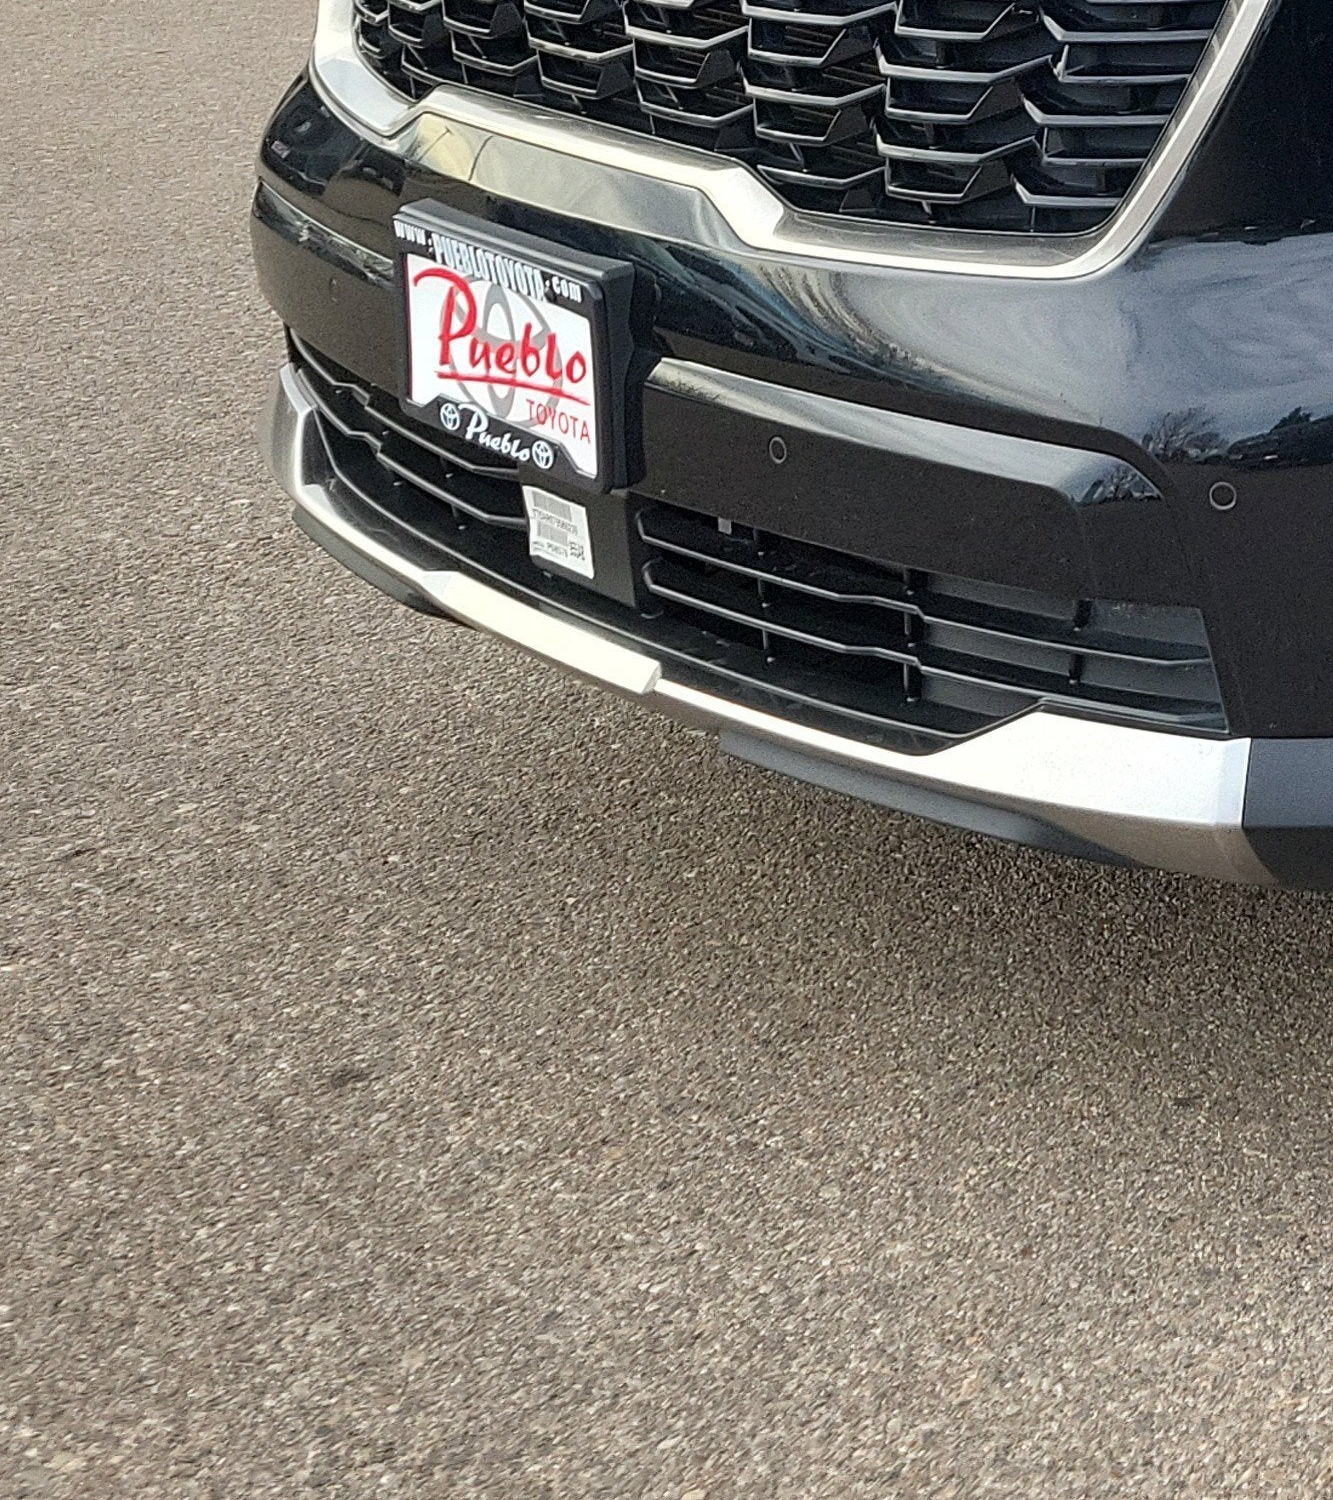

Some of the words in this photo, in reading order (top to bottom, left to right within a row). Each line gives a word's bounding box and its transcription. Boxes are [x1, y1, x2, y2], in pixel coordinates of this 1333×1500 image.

[413, 268, 587, 384] Pueblo
[458, 402, 531, 462] Pueblo
[526, 399, 591, 444] TOYOTA
